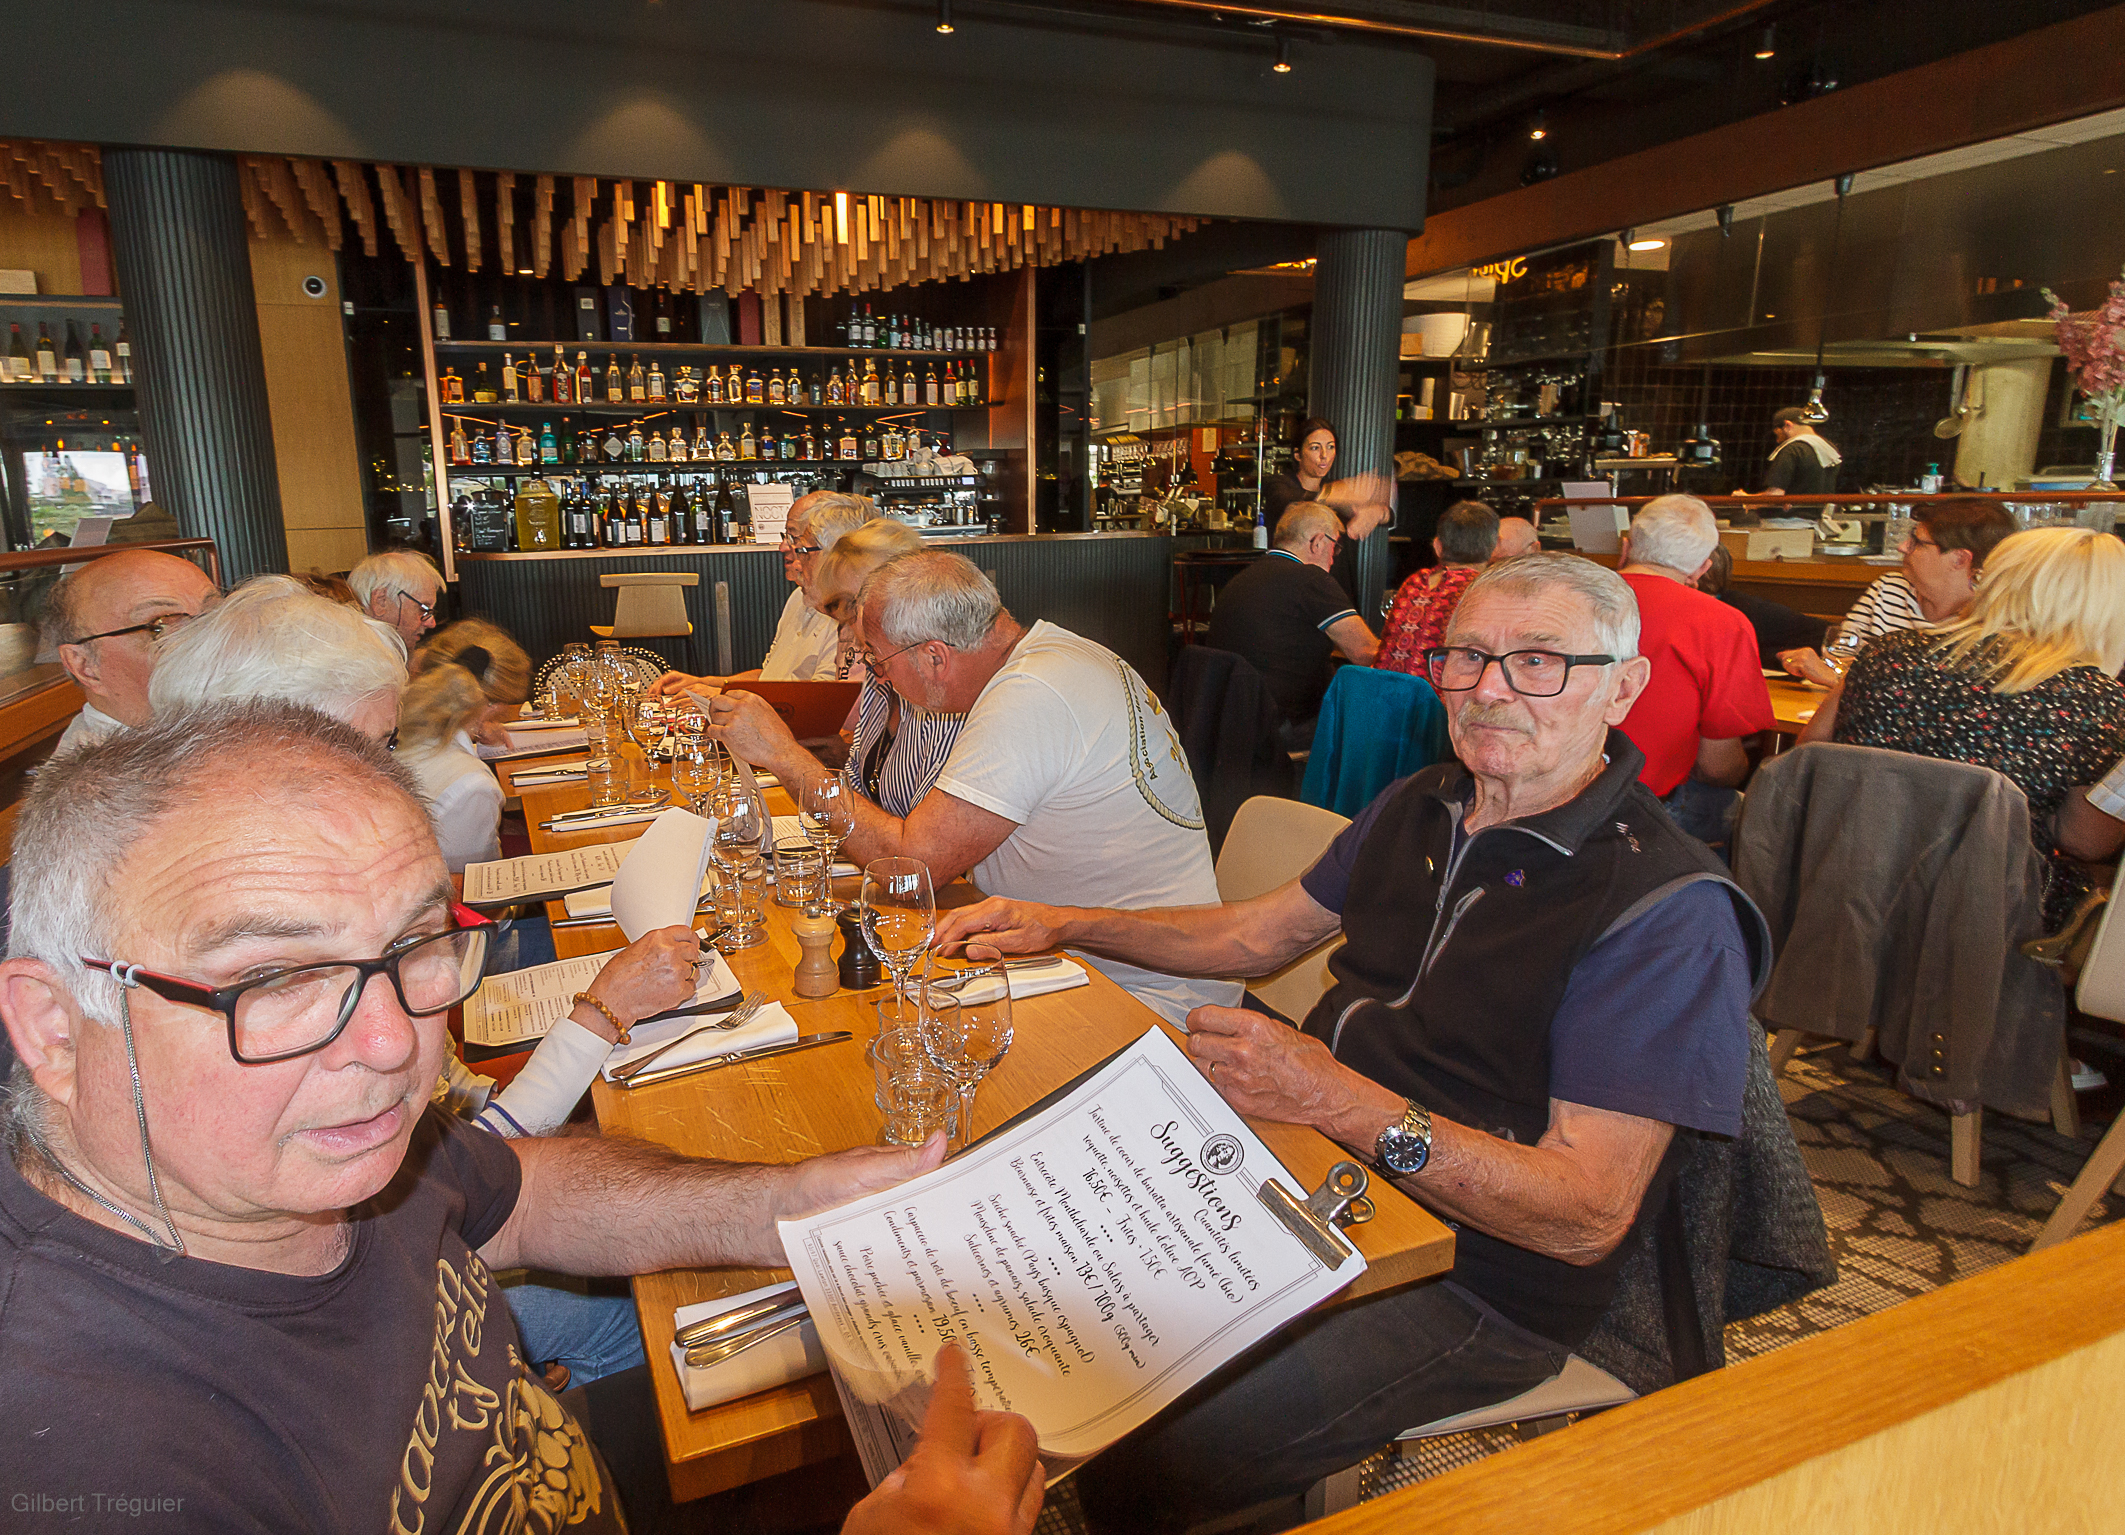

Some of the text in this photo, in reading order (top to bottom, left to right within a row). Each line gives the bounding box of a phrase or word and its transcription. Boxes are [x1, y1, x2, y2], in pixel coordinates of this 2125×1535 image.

[754, 505, 789, 519] NOCT
[1009, 1155, 1039, 1199] Béarnaise
[1149, 1120, 1242, 1232] Suggestions
[1034, 1199, 1046, 1208] et
[1036, 1205, 1059, 1232] frites
[1082, 1166, 1114, 1203] 16.50€
[1115, 1212, 1138, 1246] Frites
[1139, 1247, 1168, 1280] 1.50€
[1087, 1103, 1111, 1135] Tartine
[1108, 1134, 1122, 1146] de
[1132, 1167, 1147, 1179] de
[1140, 1176, 1167, 1211] buratta
[1165, 1210, 1204, 1255] artisanale
[1193, 1251, 1223, 1279] fumé
[1217, 1277, 1244, 1304] (bio)
[883, 1210, 912, 1260] Condiments
[1029, 1151, 1057, 1189] Entrecôte
[1092, 1249, 1104, 1262] ou
[1101, 1261, 1126, 1294] Salers
[1121, 1302, 1160, 1347] partager
[1054, 1230, 1078, 1265] maison
[1106, 1168, 1135, 1204] noisettes
[1131, 1202, 1144, 1212] et
[1138, 1209, 1161, 1235] huile
[1155, 1234, 1180, 1264] d'olive
[1176, 1265, 1206, 1290] AOP
[1193, 1208, 1231, 1254] Quantités
[1227, 1250, 1261, 1292] limitées
[859, 1246, 875, 1271] Poire
[903, 1206, 928, 1247] Carpaccio
[925, 1247, 939, 1258] de
[940, 1278, 955, 1290] de
[958, 1318, 969, 1331] en
[965, 1331, 985, 1358] basse
[906, 1260, 918, 1271] et
[987, 1193, 1096, 1364] Seiche snacké (Pays basque espagnol)
[832, 1240, 888, 1350] sauce chocolat grands crus
[864, 1271, 889, 1298] pochée
[882, 1300, 894, 1309] et
[906, 1270, 936, 1314] parmesan
[963, 1233, 1041, 1359] Salicornes et agrumes 26€
[881, 1310, 903, 1333] glace
[995, 1246, 1009, 1258] de
[1017, 1291, 1046, 1324] salade
[1037, 1325, 1071, 1376] croquante
